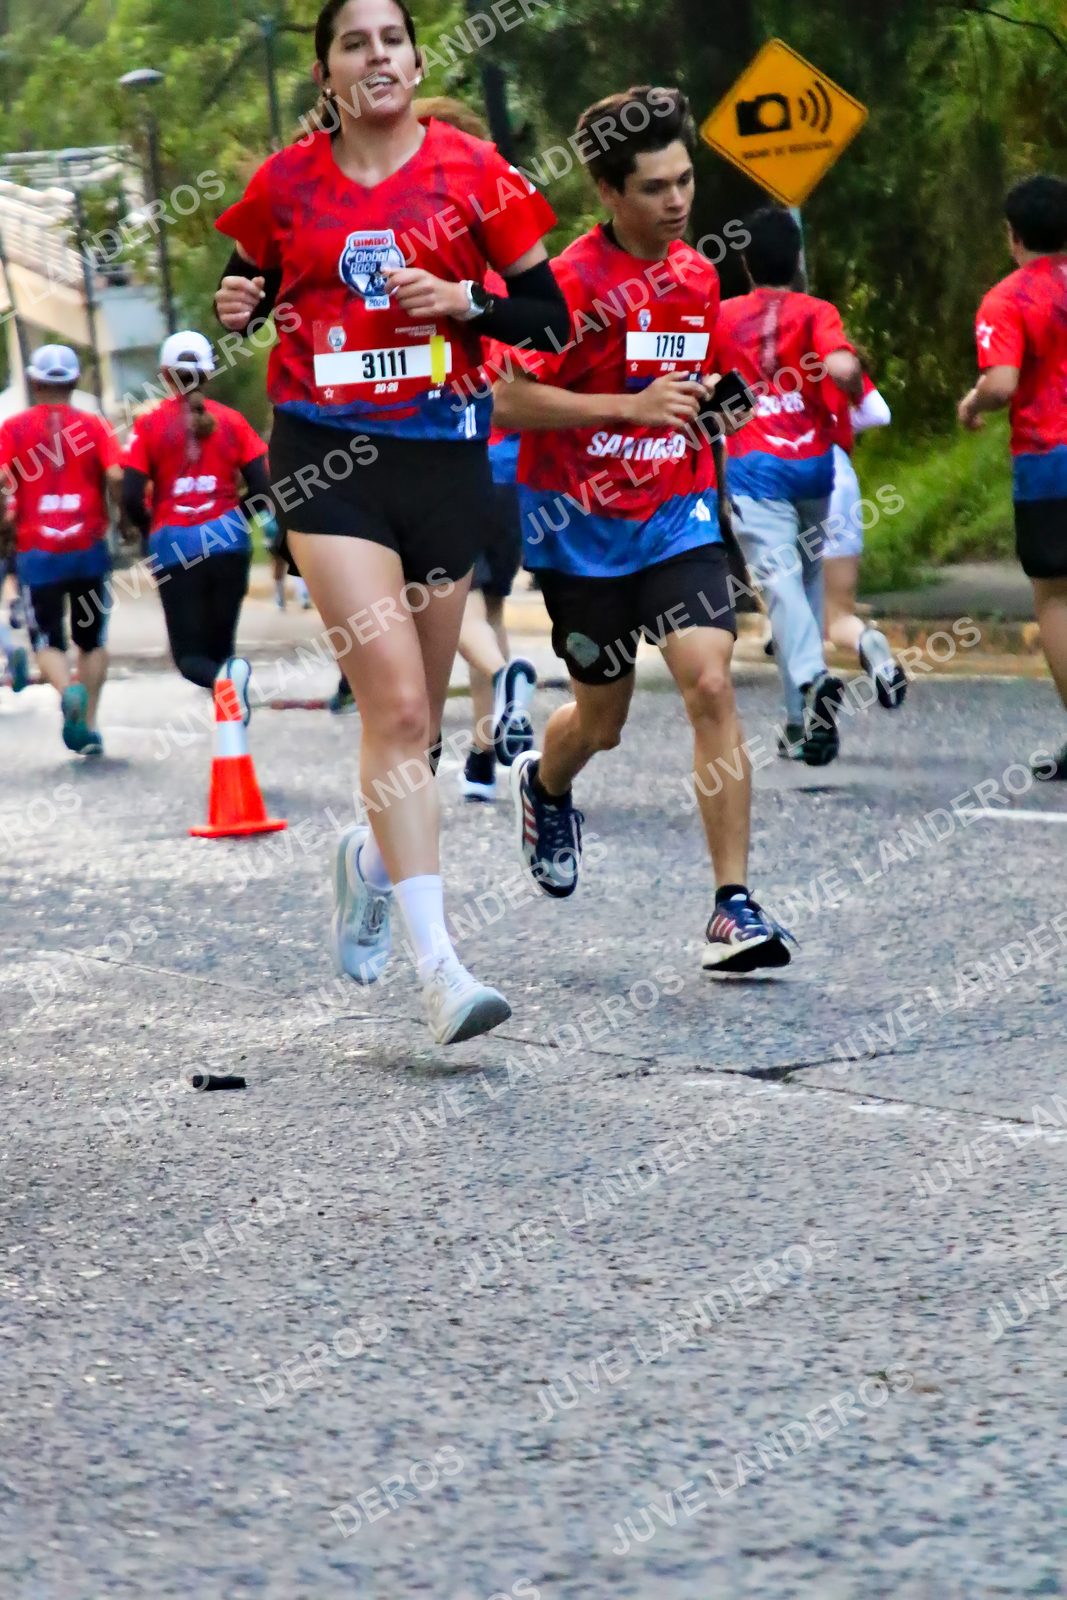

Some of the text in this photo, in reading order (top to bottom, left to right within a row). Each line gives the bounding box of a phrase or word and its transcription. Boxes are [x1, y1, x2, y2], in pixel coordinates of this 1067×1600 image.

[356, 250, 389, 263] Global
[350, 262, 377, 274] Race
[656, 335, 685, 358] 1719
[362, 350, 407, 379] 3111
